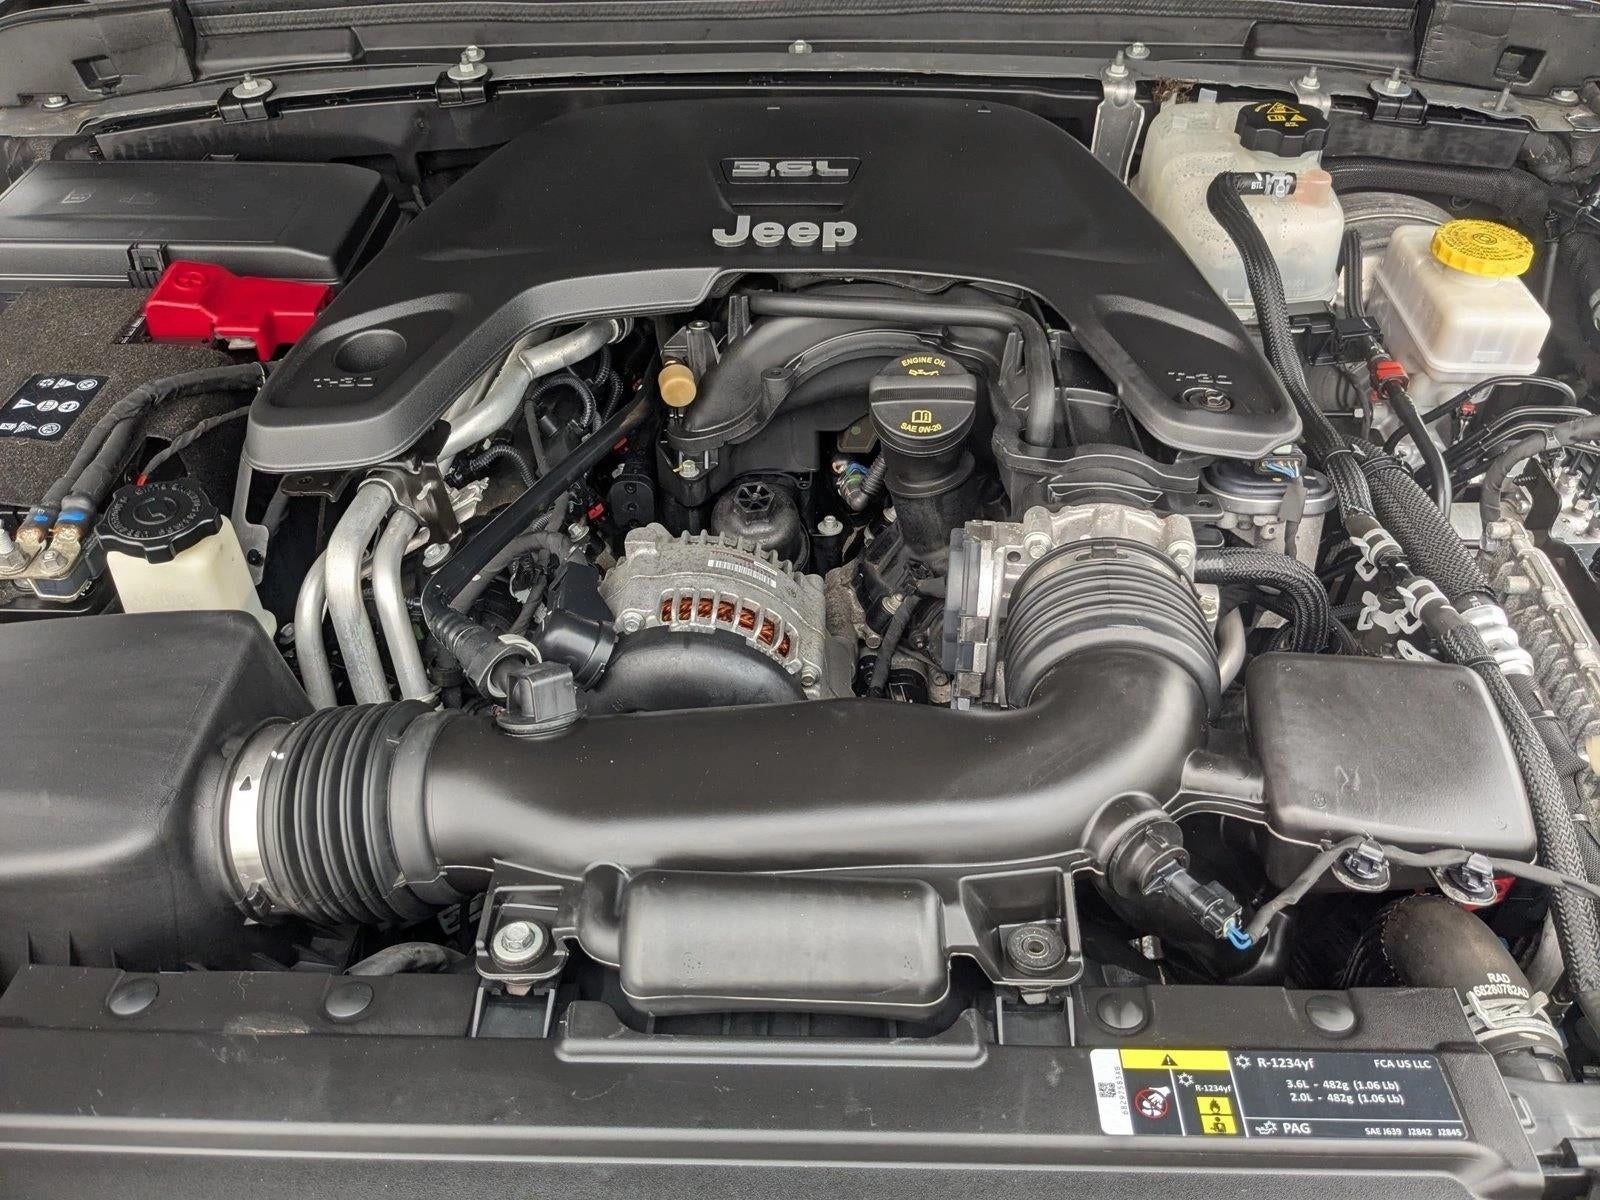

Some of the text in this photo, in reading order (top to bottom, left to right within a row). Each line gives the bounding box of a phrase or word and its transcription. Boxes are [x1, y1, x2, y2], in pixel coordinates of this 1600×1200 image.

[1250, 181, 1264, 190] BTL
[712, 215, 858, 251] Jeep
[901, 356, 946, 368] ENGINE OIL
[900, 422, 917, 433] SAE
[1486, 972, 1511, 984] RAD
[1257, 1057, 1315, 1071] R-1234yf
[1373, 1059, 1432, 1069] FCA US LLC
[1195, 1084, 1232, 1094] R-1234yf
[1285, 1079, 1309, 1089] 3.6L
[1322, 1080, 1350, 1091] 482g
[1353, 1079, 1381, 1091] (1.06
[1381, 1080, 1400, 1092] Lb)
[1289, 1092, 1314, 1102] 2.0L
[1326, 1093, 1354, 1104] 482g
[1357, 1093, 1386, 1105] (1.06
[1386, 1094, 1405, 1106] Lb)
[1282, 1122, 1312, 1134] PAG
[1364, 1127, 1463, 1137] SAE J639 J2842 J2845
